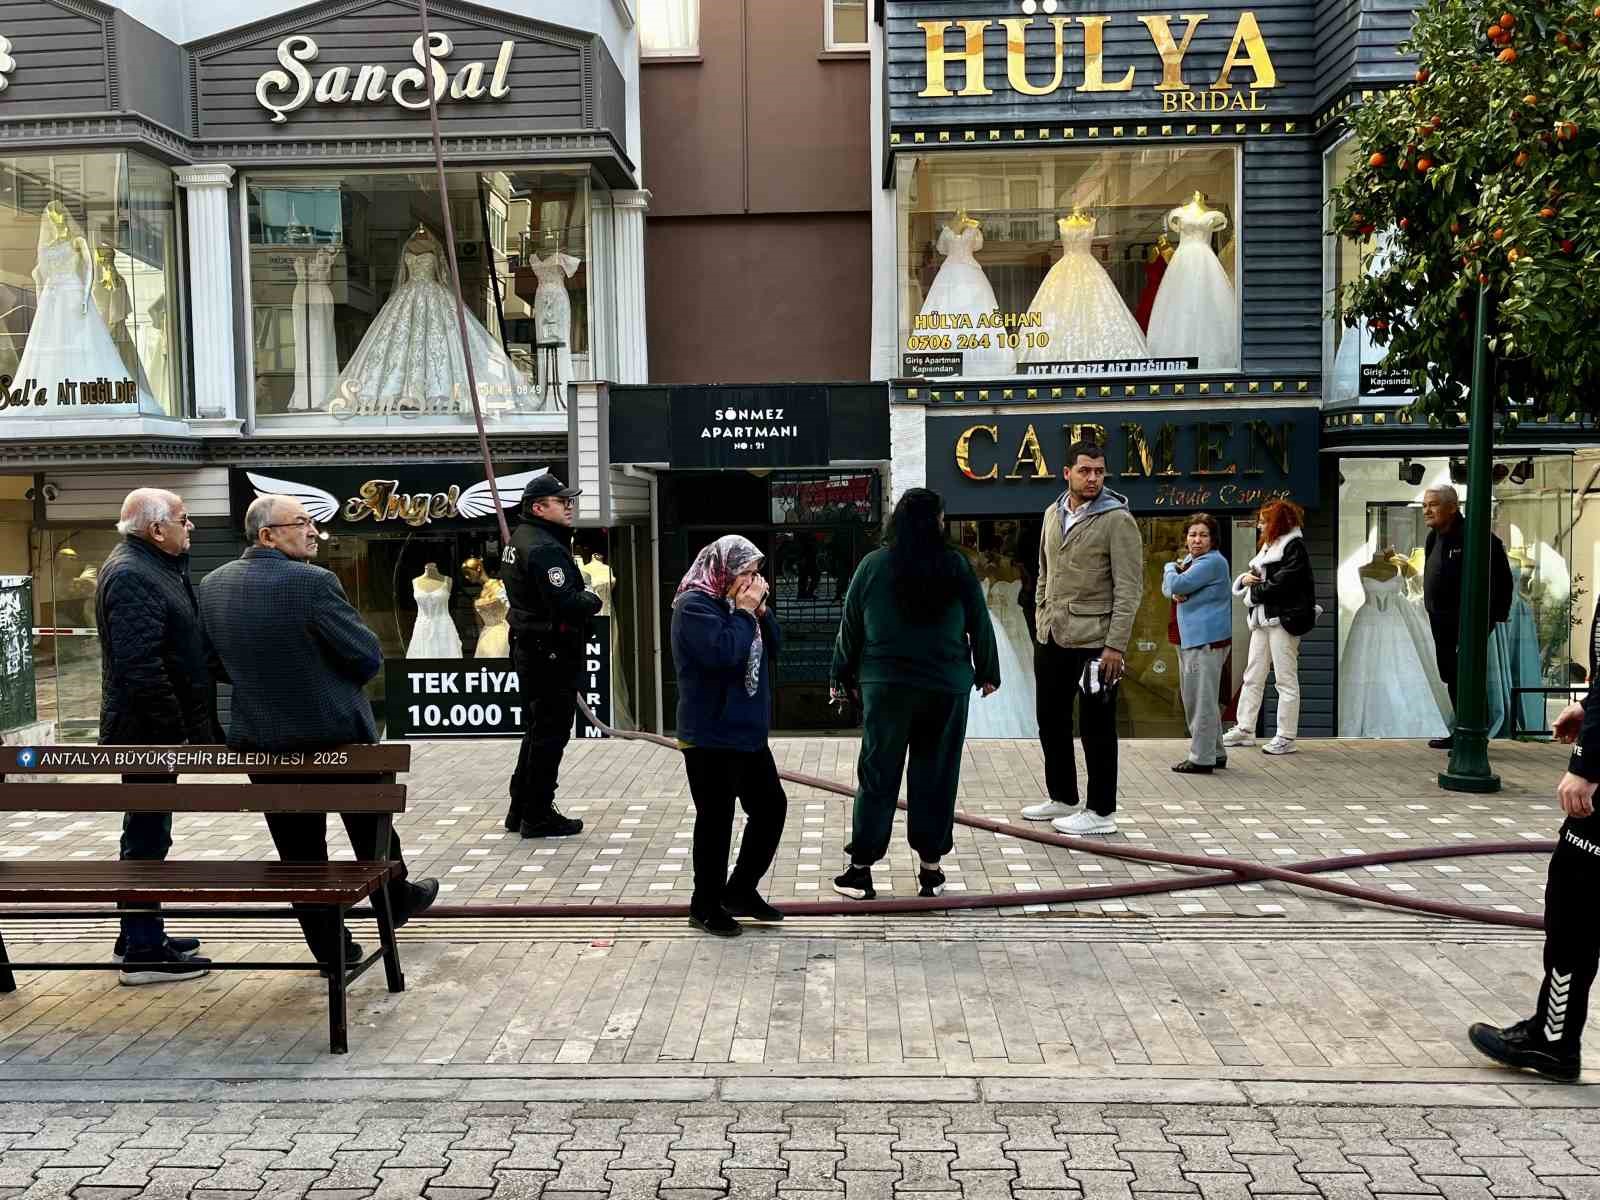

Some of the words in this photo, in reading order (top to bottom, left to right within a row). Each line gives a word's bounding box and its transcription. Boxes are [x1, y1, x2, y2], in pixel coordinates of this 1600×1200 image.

[917, 0, 1279, 98] HÜLYA
[1162, 91, 1267, 113] BRIDAL
[914, 311, 973, 329] HÜLYA
[976, 309, 1042, 328] AĞHAN
[907, 334, 952, 350] 0506
[957, 333, 990, 349] 264
[996, 332, 1020, 348] 10
[1025, 331, 1050, 347] 10
[905, 357, 923, 365] Giriş
[924, 356, 960, 365] Apartman
[912, 365, 954, 373] Kapısından
[57, 378, 78, 405] AİT
[80, 377, 138, 405] DEĞİLDİR
[715, 407, 784, 420] SÖNMEZ
[701, 426, 797, 438] APARTMANI
[343, 479, 460, 527] Angel
[408, 672, 459, 694] TEK
[408, 704, 502, 726] 10.000
[41, 752, 110, 765] ANTALYA
[114, 750, 213, 771] BÜYÜKŞEHİR
[313, 752, 348, 765] 2025
